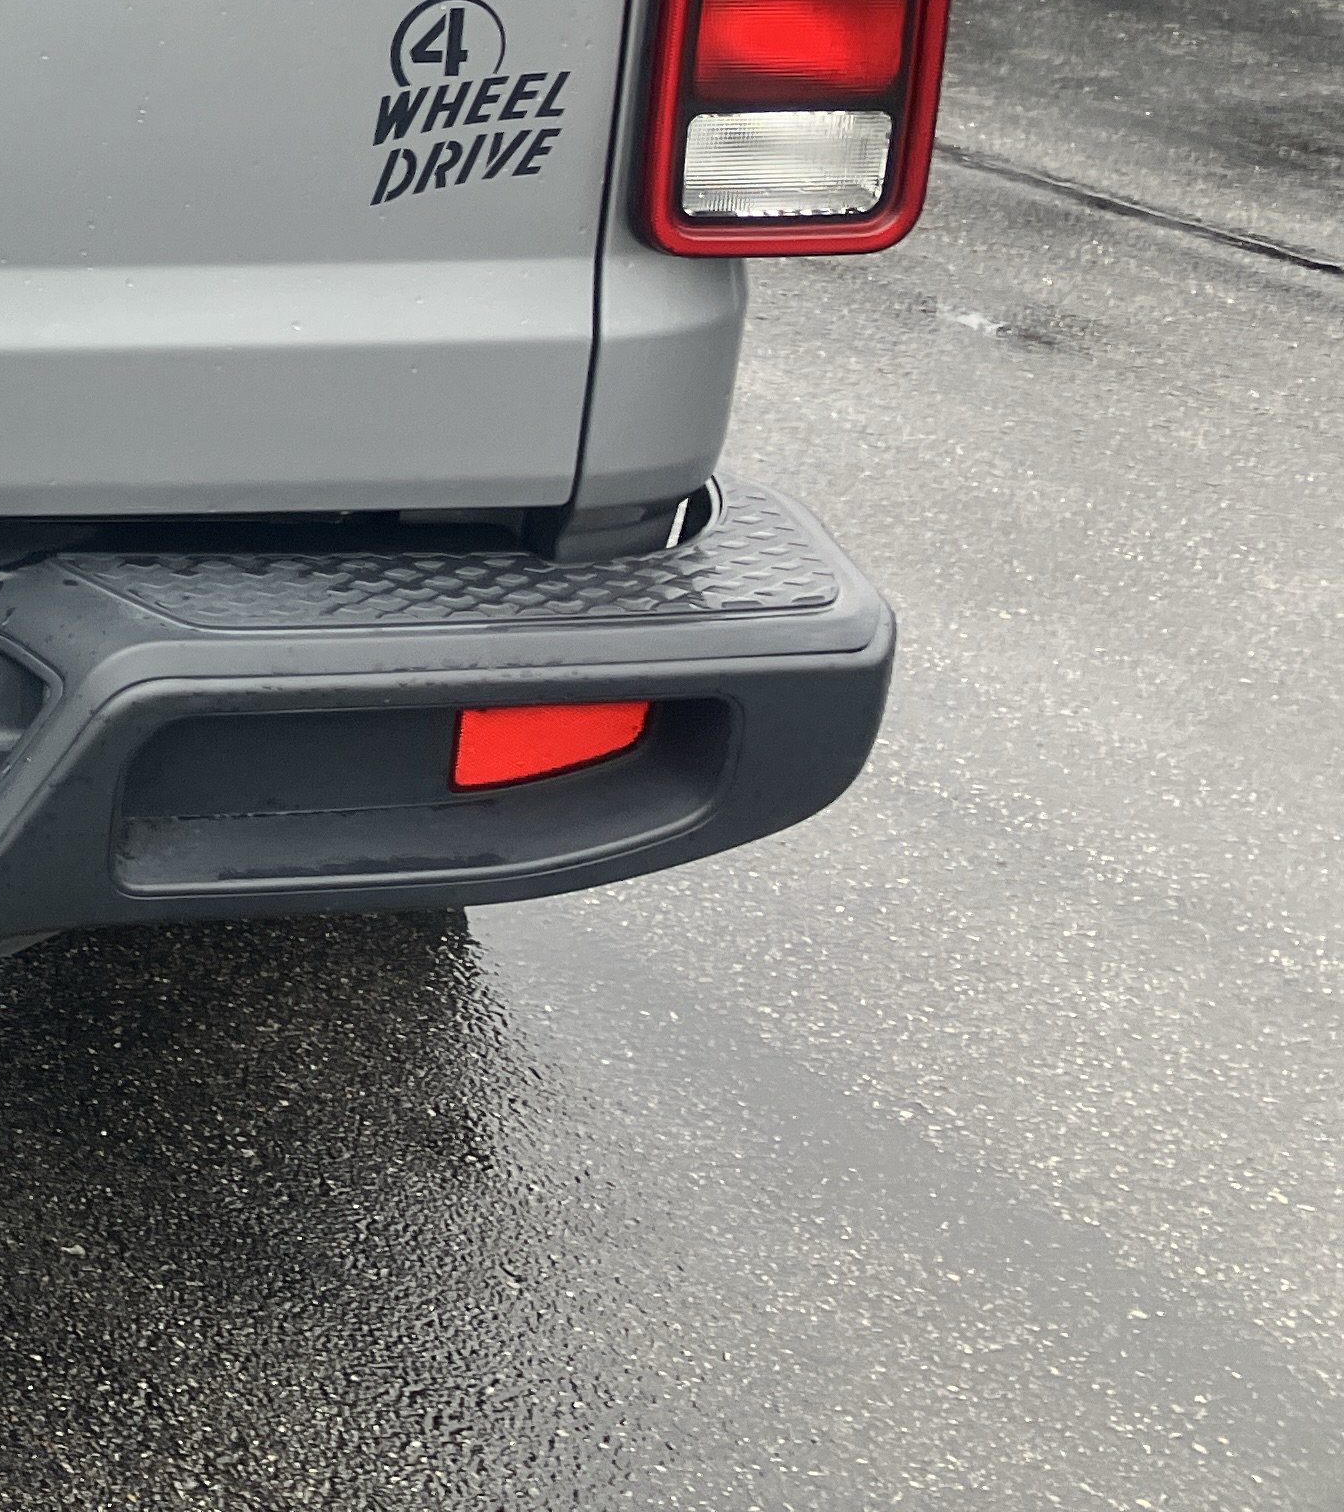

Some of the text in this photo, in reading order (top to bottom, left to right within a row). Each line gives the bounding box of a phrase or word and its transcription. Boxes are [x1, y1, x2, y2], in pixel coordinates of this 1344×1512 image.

[409, 7, 468, 76] 4
[373, 71, 571, 146] WHEEL
[370, 128, 562, 206] DRIVE
